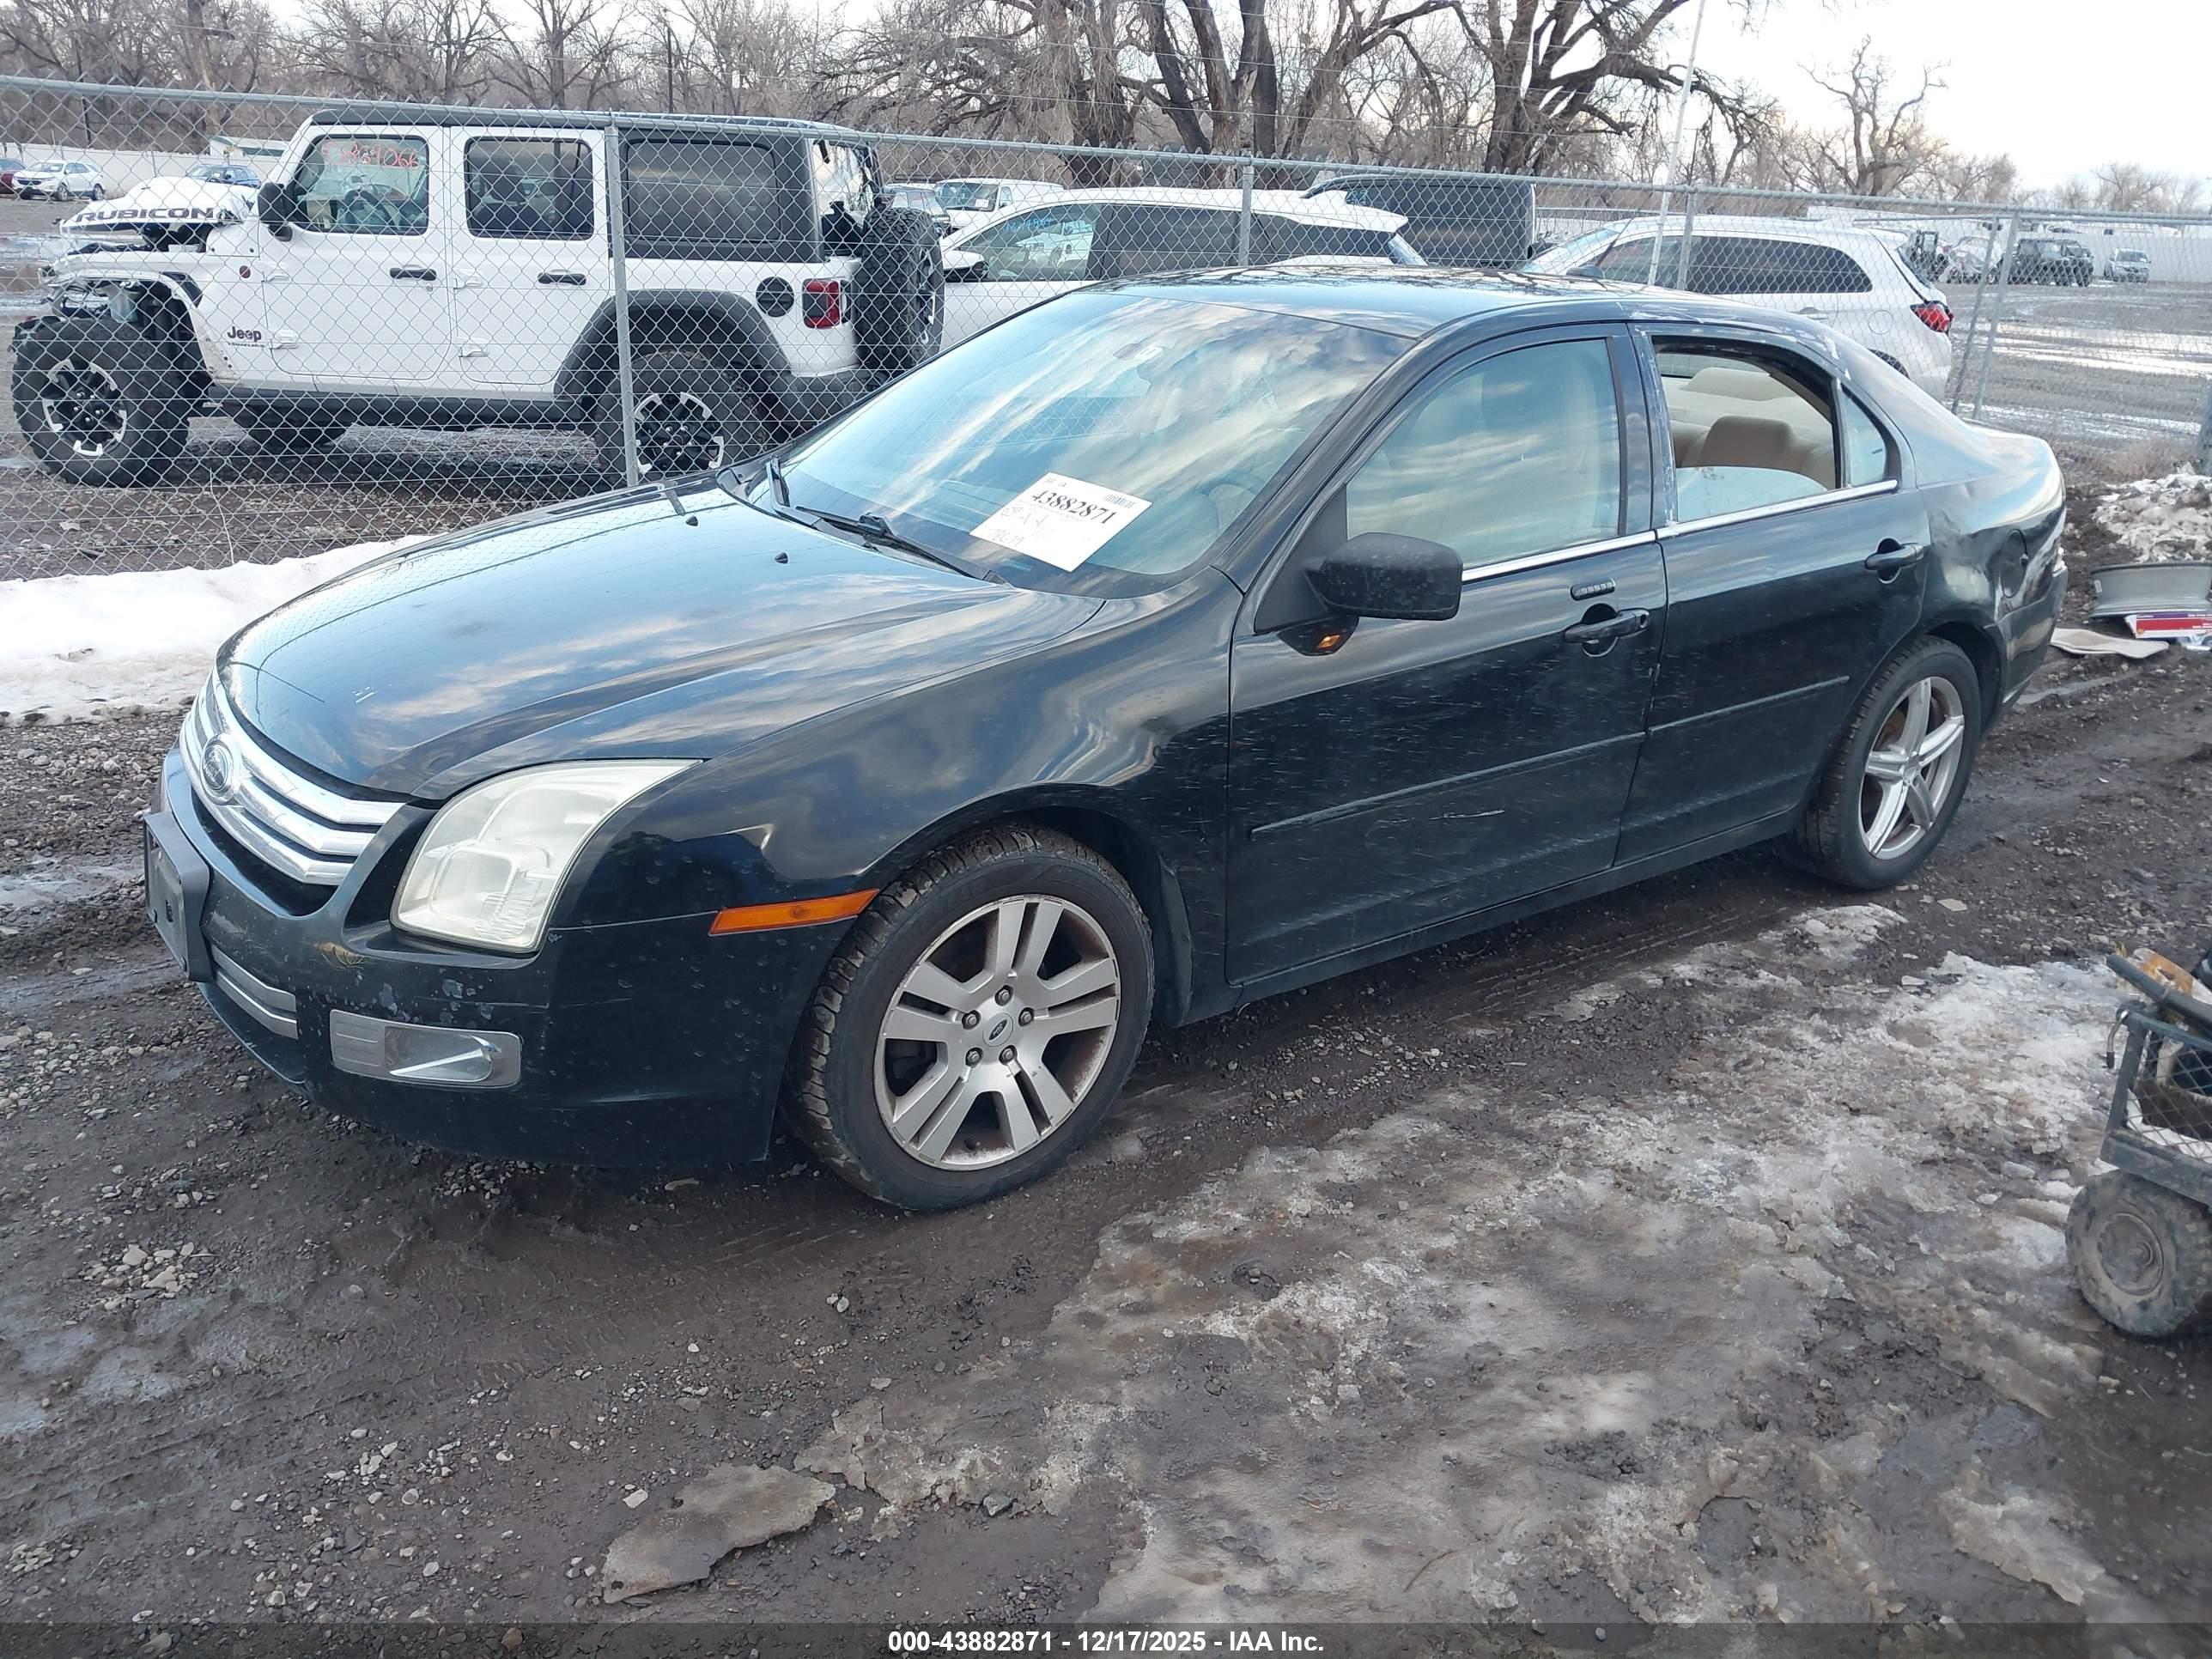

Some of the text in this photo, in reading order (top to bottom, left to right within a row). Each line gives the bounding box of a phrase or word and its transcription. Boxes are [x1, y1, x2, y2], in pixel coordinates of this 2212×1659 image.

[76, 207, 215, 222] RUBICON
[227, 325, 262, 343] Jeep
[1031, 489, 1117, 525] 43882871
